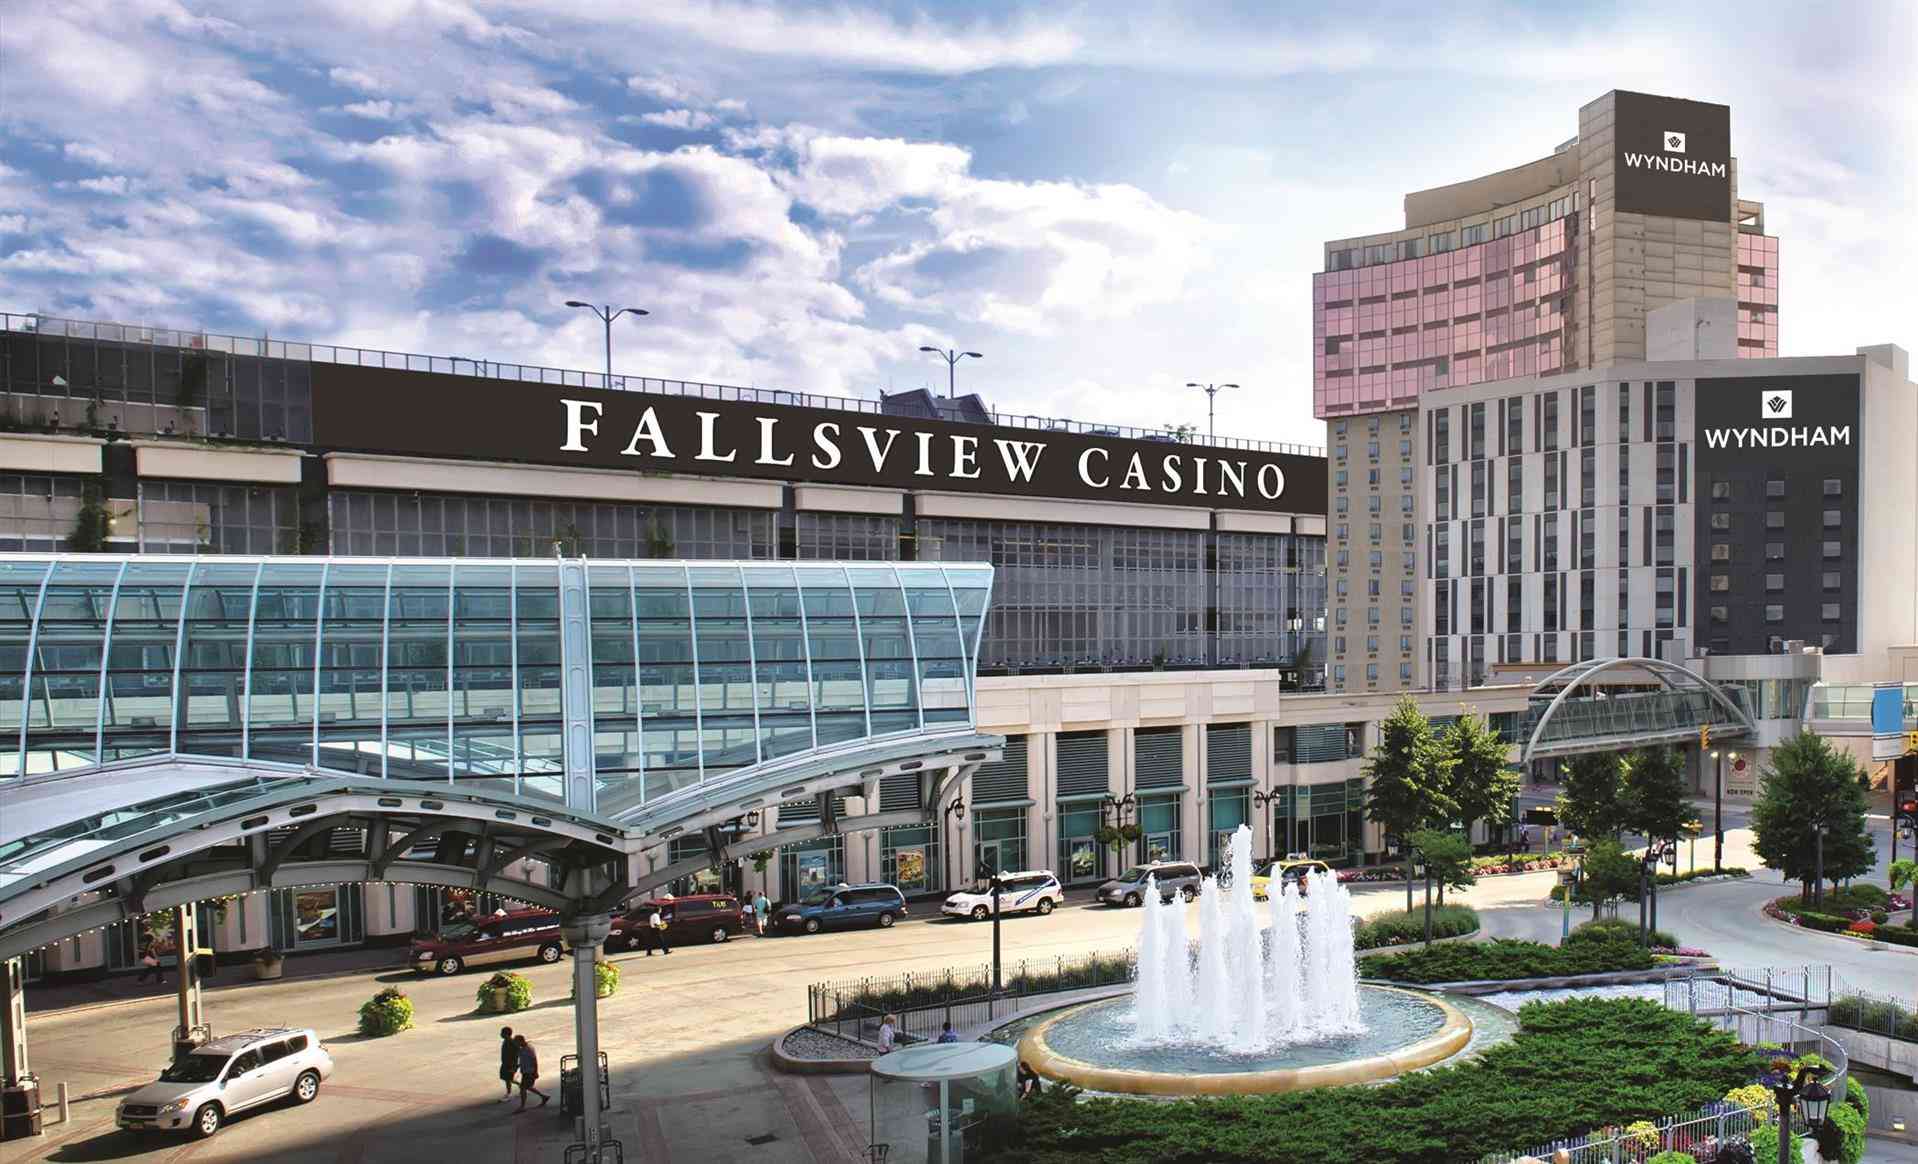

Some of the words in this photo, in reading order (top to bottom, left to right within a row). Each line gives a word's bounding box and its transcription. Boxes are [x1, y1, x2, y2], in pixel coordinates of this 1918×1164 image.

[1624, 152, 1726, 178] WYNDHAM
[559, 398, 1047, 483] FALLSVIEW
[1078, 447, 1286, 500] CASINO
[1704, 426, 1850, 449] WYNDHAM
